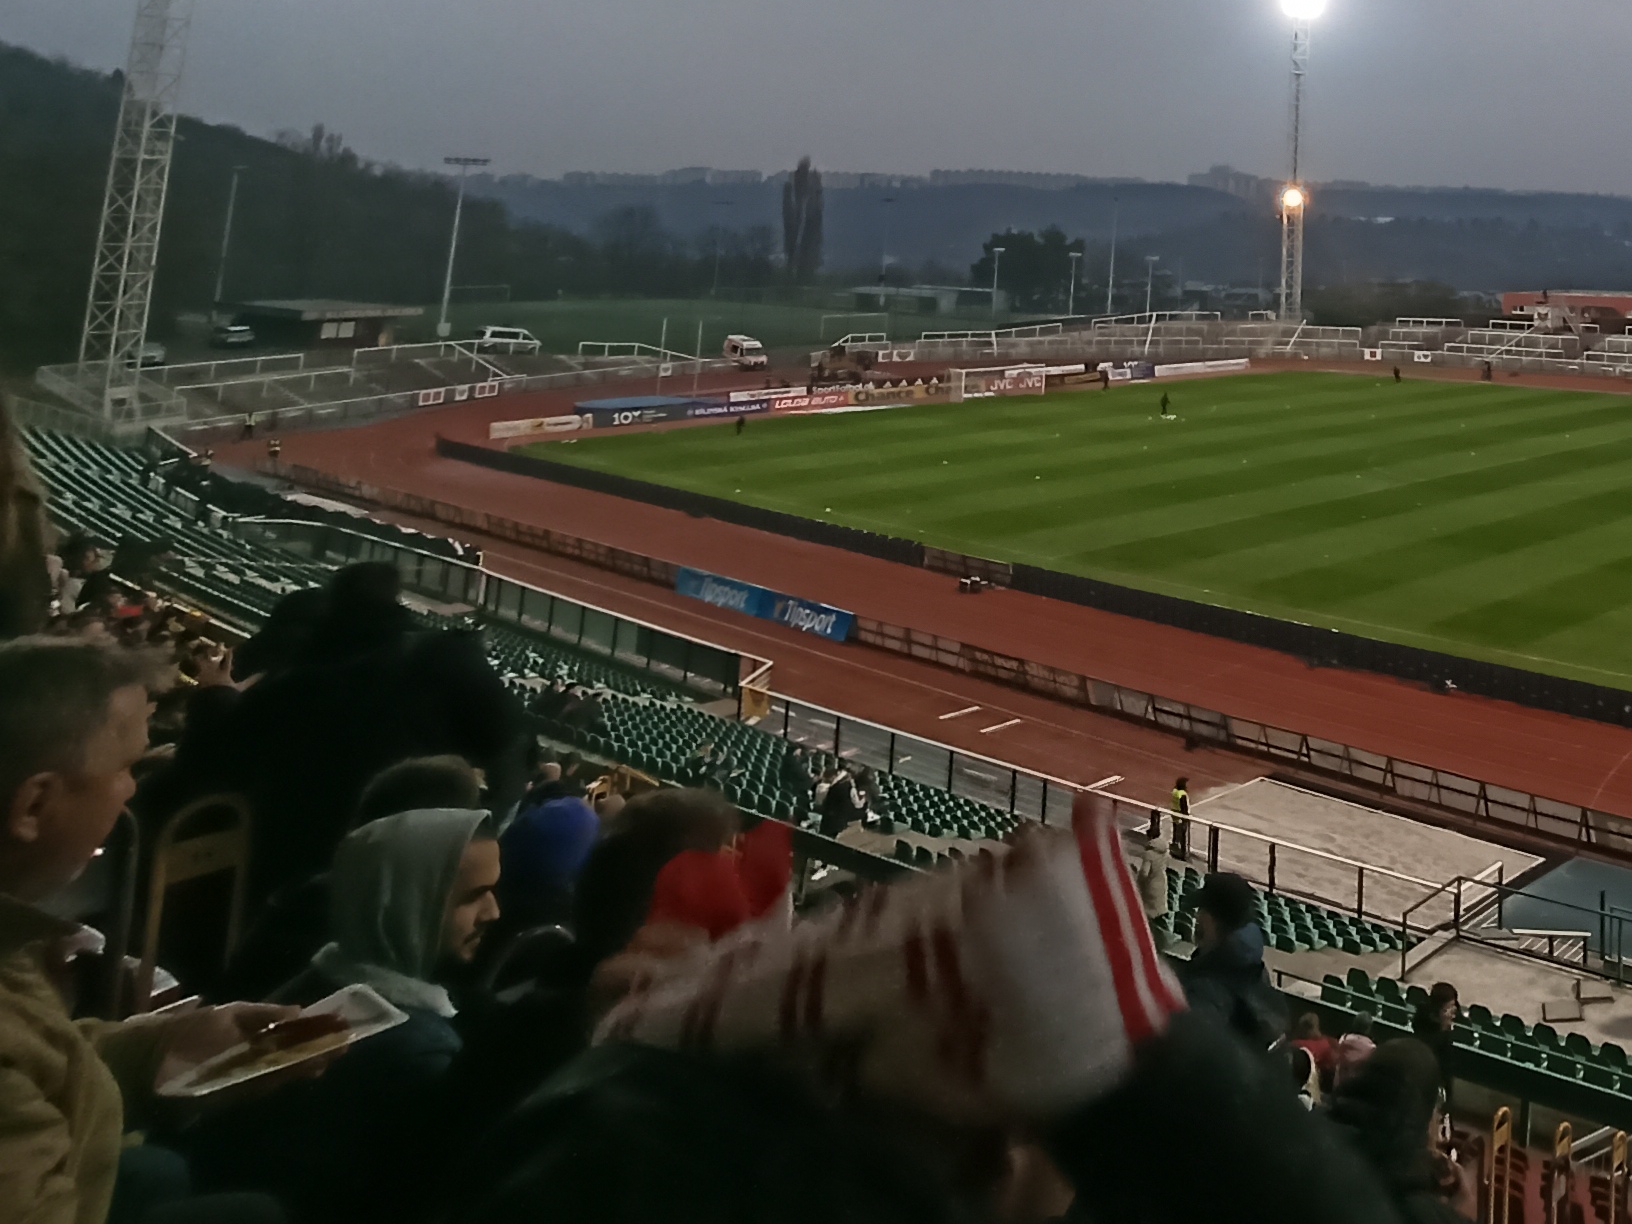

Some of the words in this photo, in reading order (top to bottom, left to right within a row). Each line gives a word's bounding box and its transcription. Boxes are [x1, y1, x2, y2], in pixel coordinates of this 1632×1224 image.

[989, 378, 1013, 391] JVC
[1018, 376, 1041, 389] JVC
[699, 577, 750, 608] Tipsport
[783, 598, 838, 634] Tipsport
